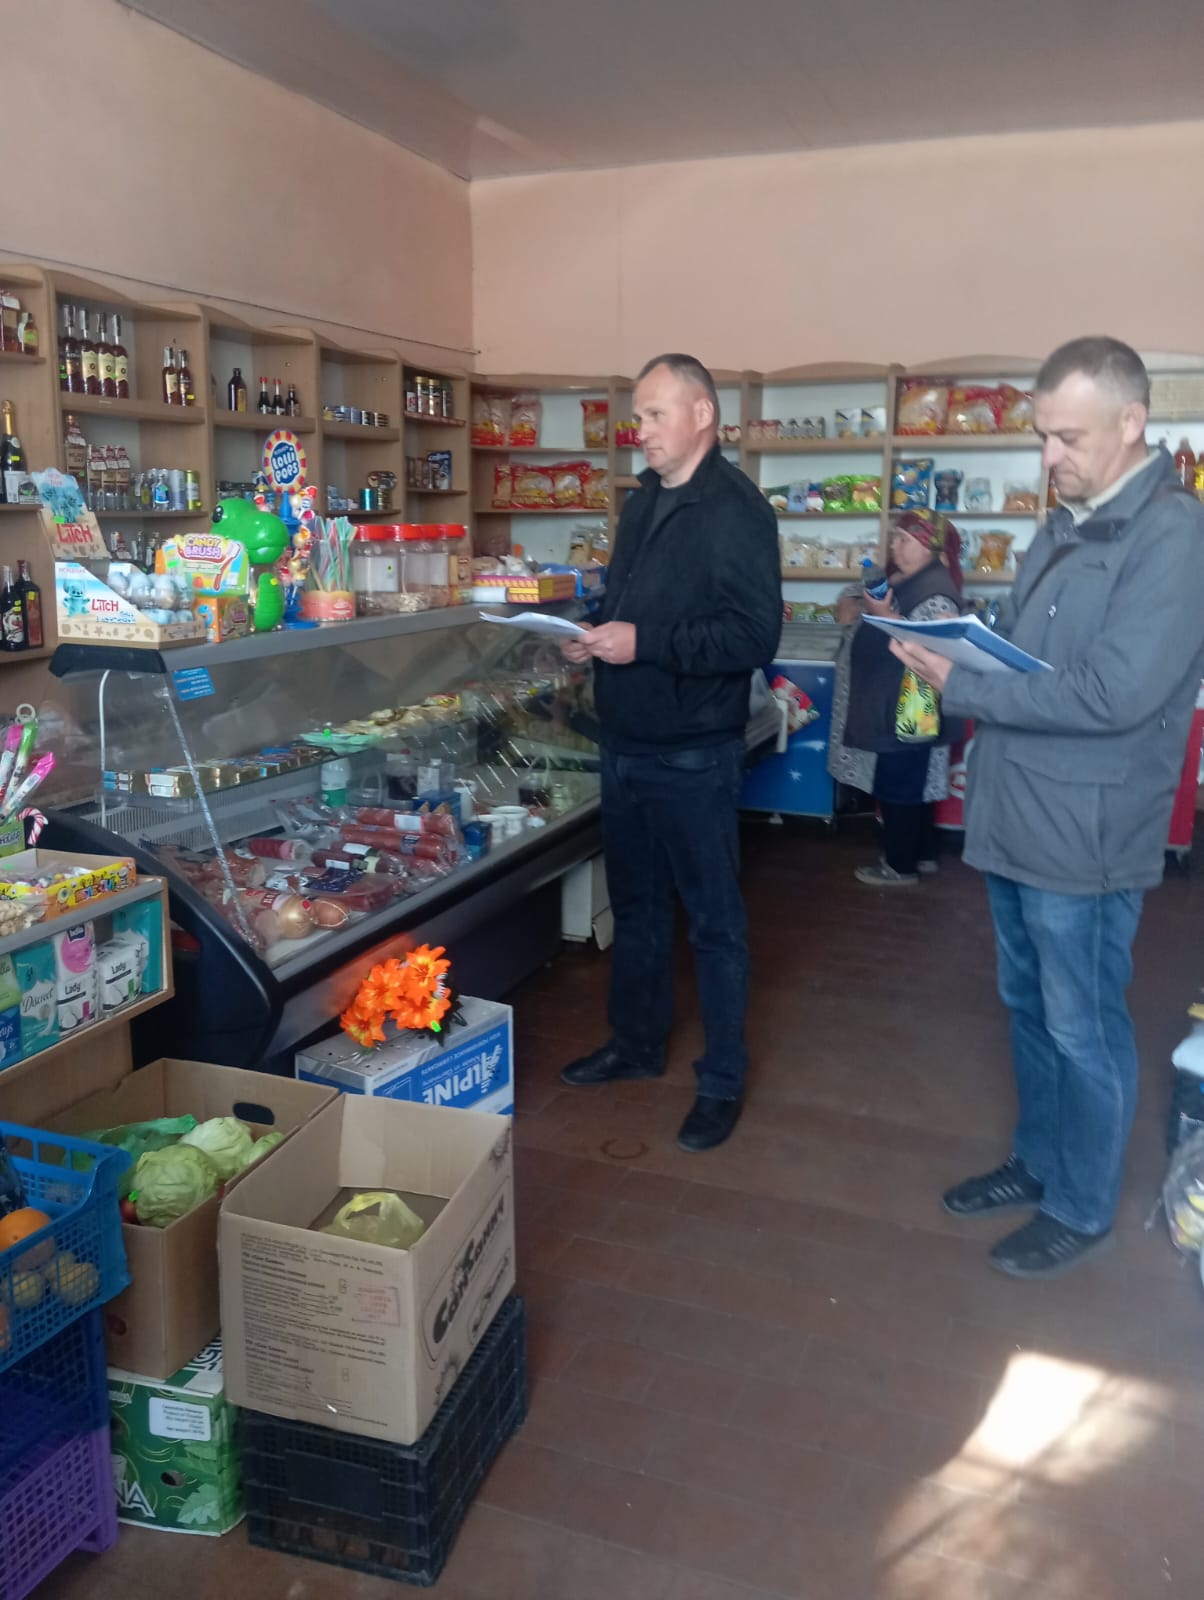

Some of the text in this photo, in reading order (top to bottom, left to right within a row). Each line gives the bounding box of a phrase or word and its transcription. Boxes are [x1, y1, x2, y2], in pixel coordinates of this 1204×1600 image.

[184, 545, 222, 558] BRUSH
[112, 961, 127, 975] Lady
[65, 982, 81, 995] Lady
[422, 1044, 502, 1106] ALPINE
